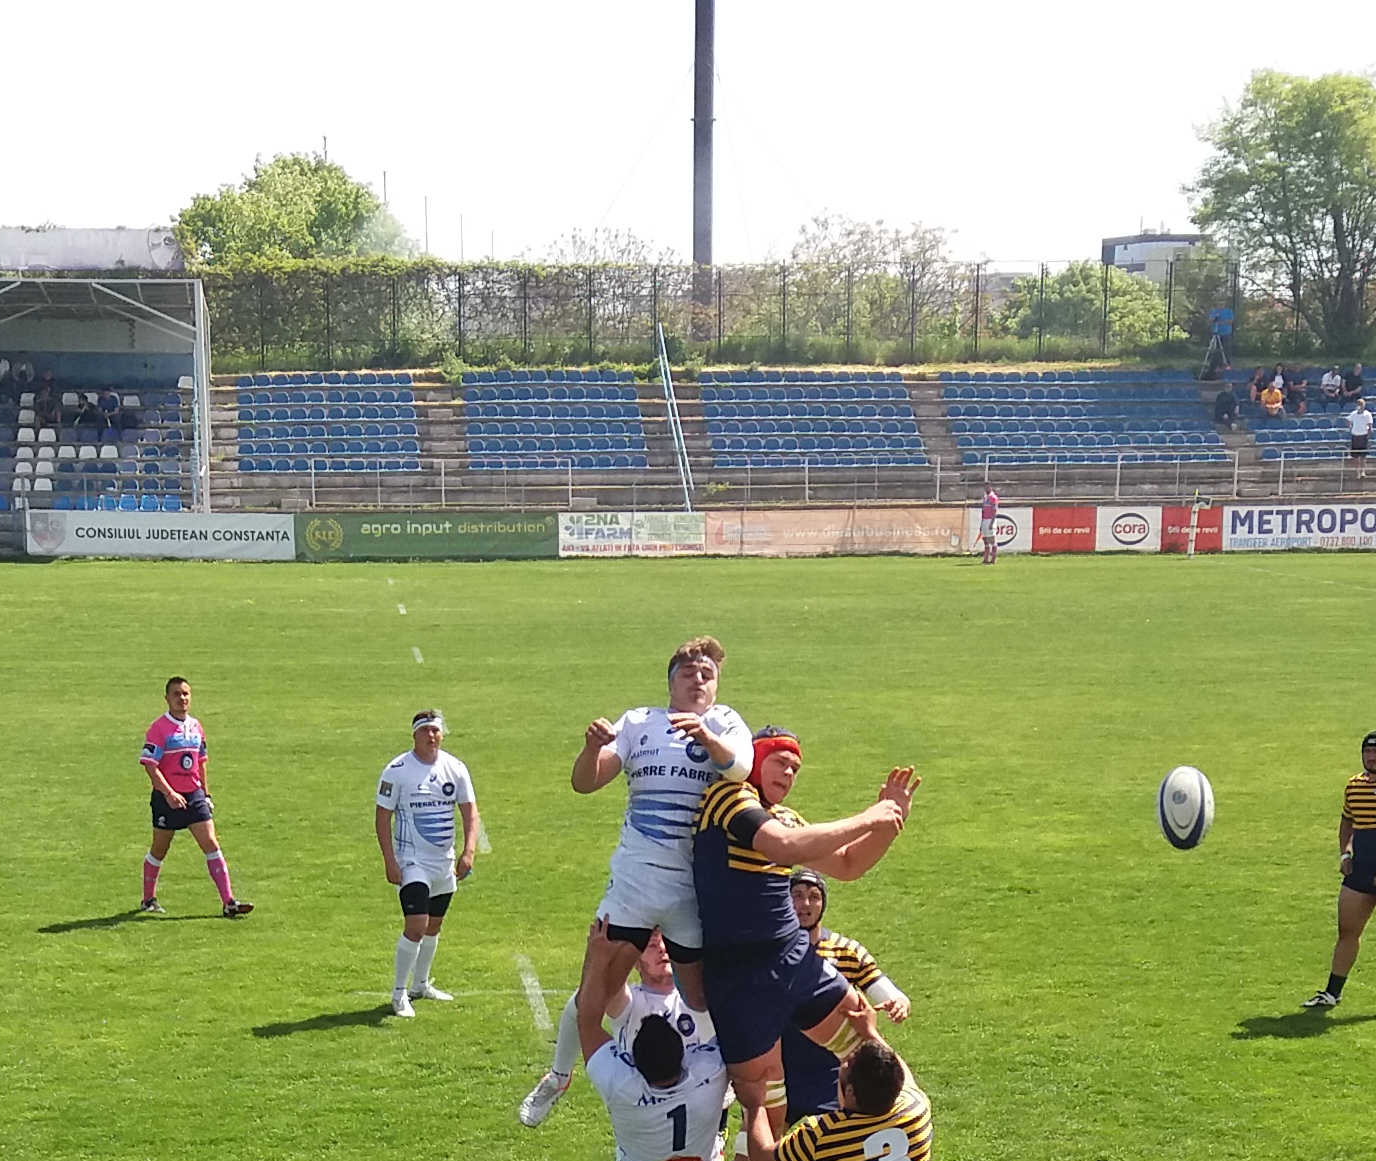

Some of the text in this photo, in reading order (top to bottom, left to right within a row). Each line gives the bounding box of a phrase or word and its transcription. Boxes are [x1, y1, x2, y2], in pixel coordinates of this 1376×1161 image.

[584, 513, 620, 526] 2NA
[75, 527, 142, 540] CONSILIUL
[360, 521, 401, 538] agro
[406, 520, 452, 538] input
[584, 527, 632, 540] FARM
[1114, 522, 1146, 536] cora
[1229, 537, 1268, 548] TRANSFER
[1270, 537, 1312, 548] AEROPORT
[670, 766, 713, 782] FABRE
[666, 1103, 687, 1152] 1
